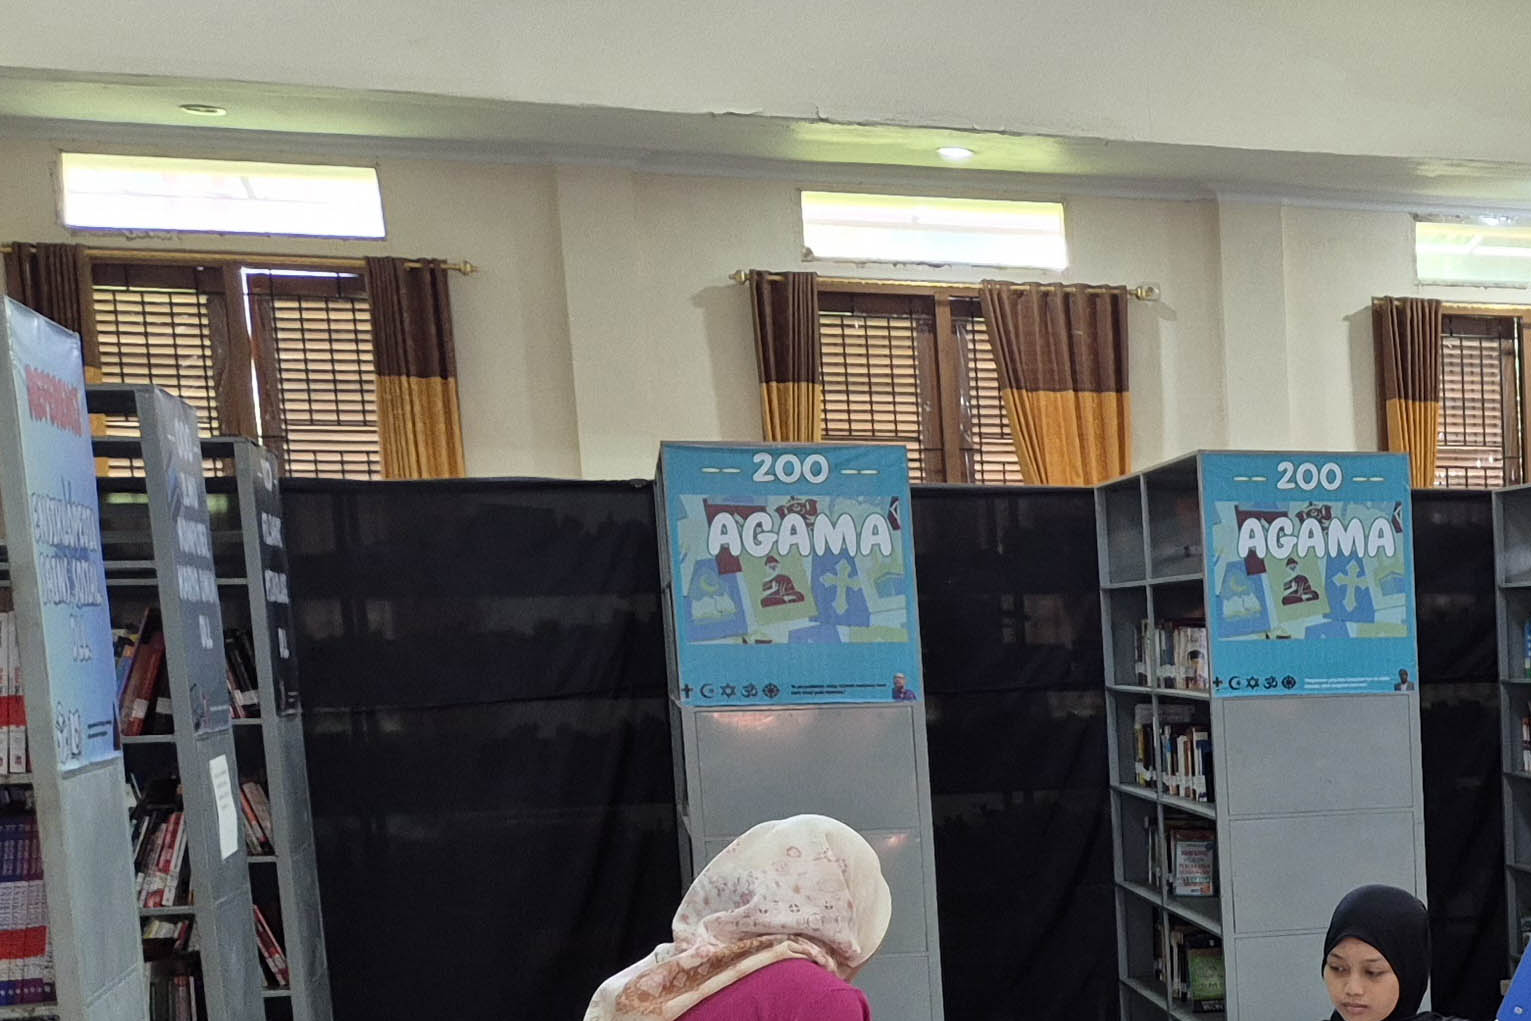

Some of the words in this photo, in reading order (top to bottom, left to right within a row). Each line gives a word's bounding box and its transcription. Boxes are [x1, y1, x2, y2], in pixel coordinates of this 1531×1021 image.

[752, 453, 830, 484] 200
[1277, 461, 1343, 491] 200
[708, 512, 893, 557] AGAMA
[1238, 517, 1396, 559] AGAMA
